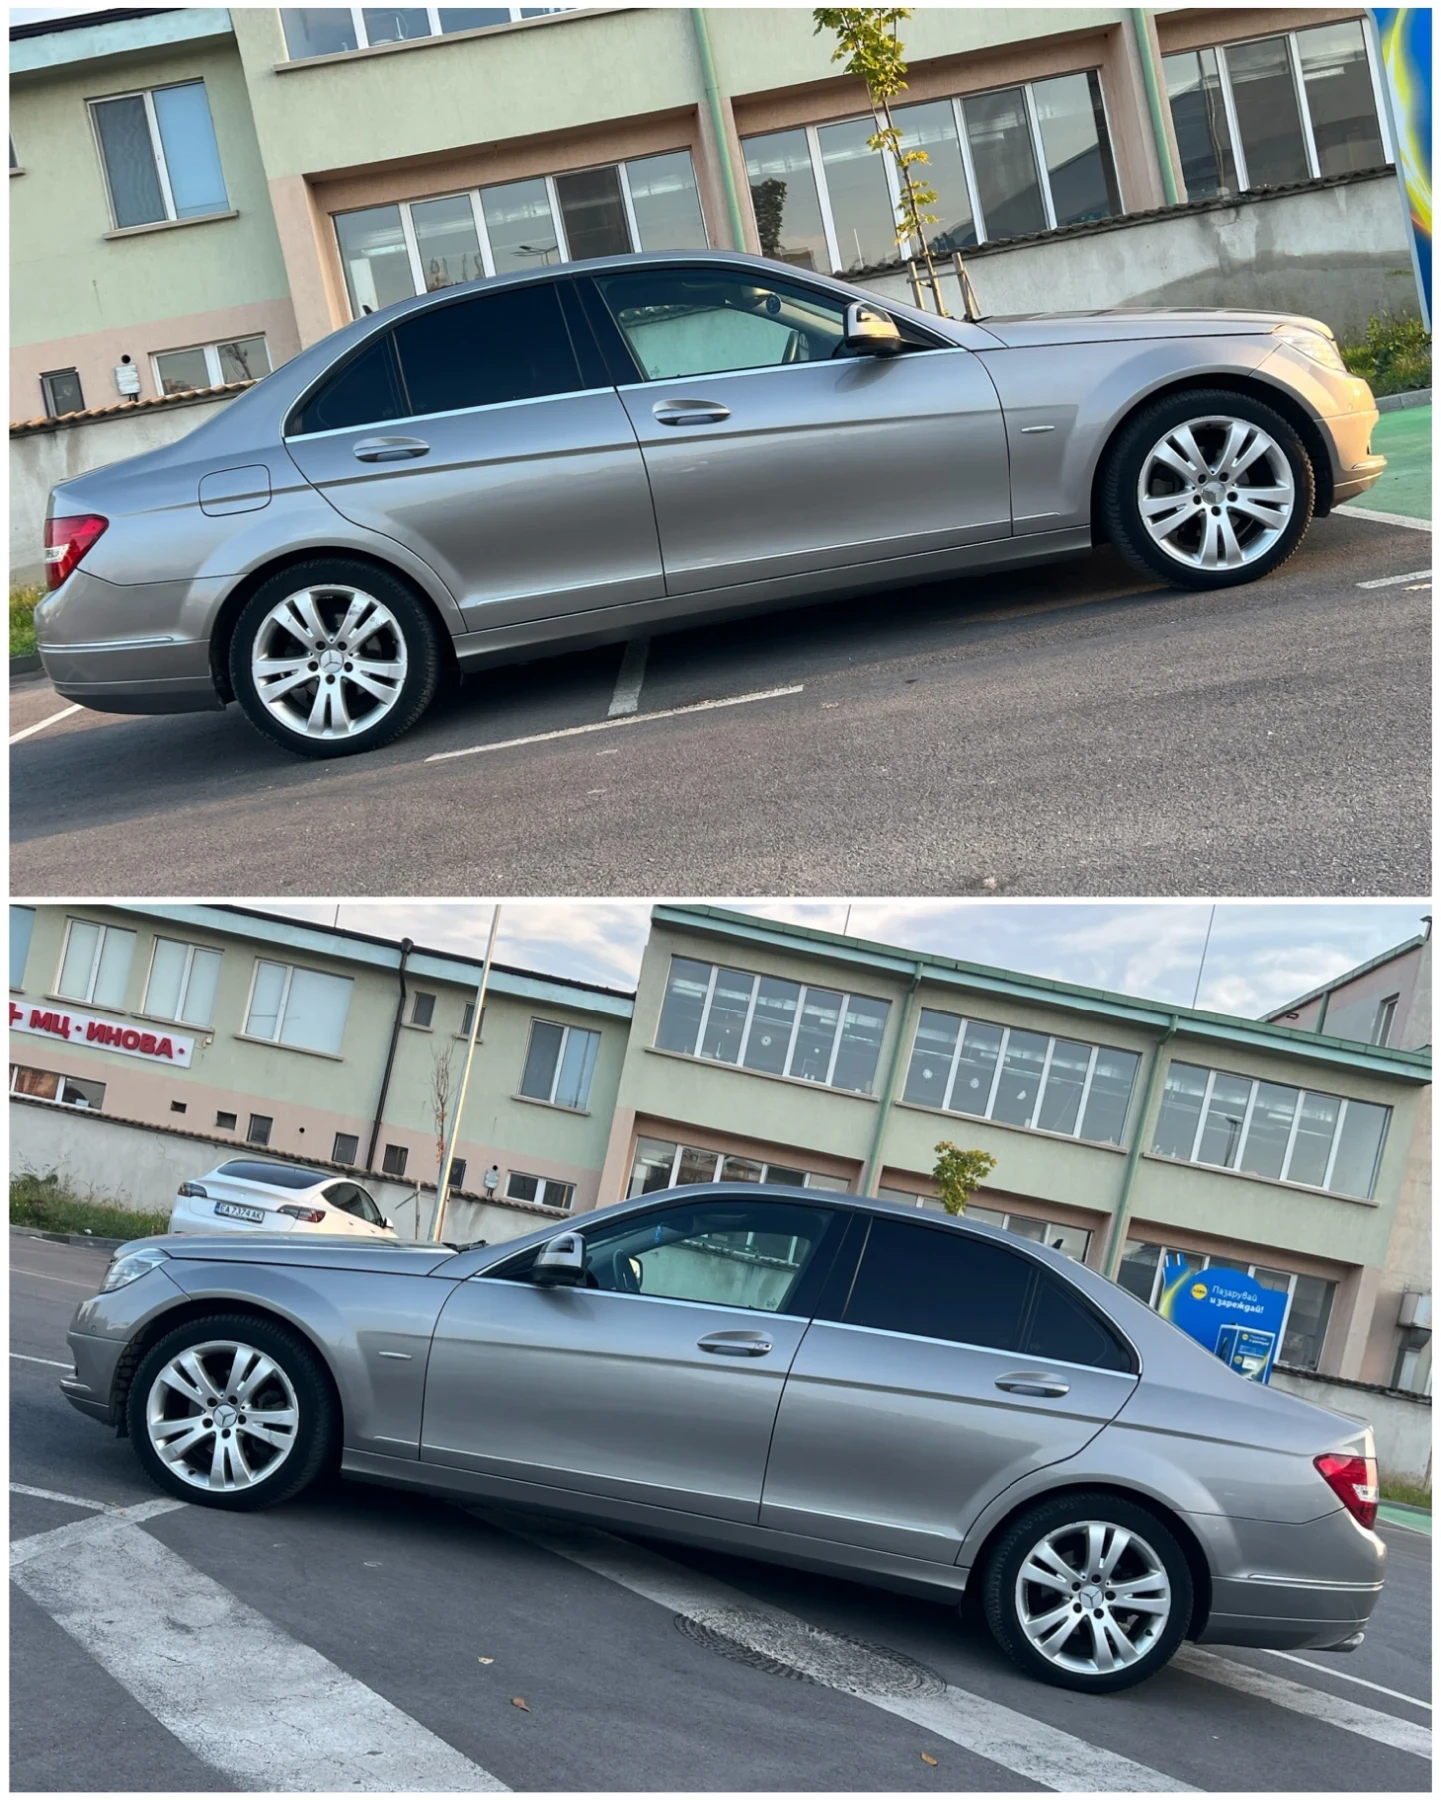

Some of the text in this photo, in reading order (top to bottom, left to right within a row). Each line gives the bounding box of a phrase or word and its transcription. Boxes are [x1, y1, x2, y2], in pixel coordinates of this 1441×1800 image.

[29, 1009, 173, 1059] МЦ ИНОВА
[1212, 1285, 1258, 1303] Пазарувай
[1216, 1298, 1265, 1314] зареждай!
